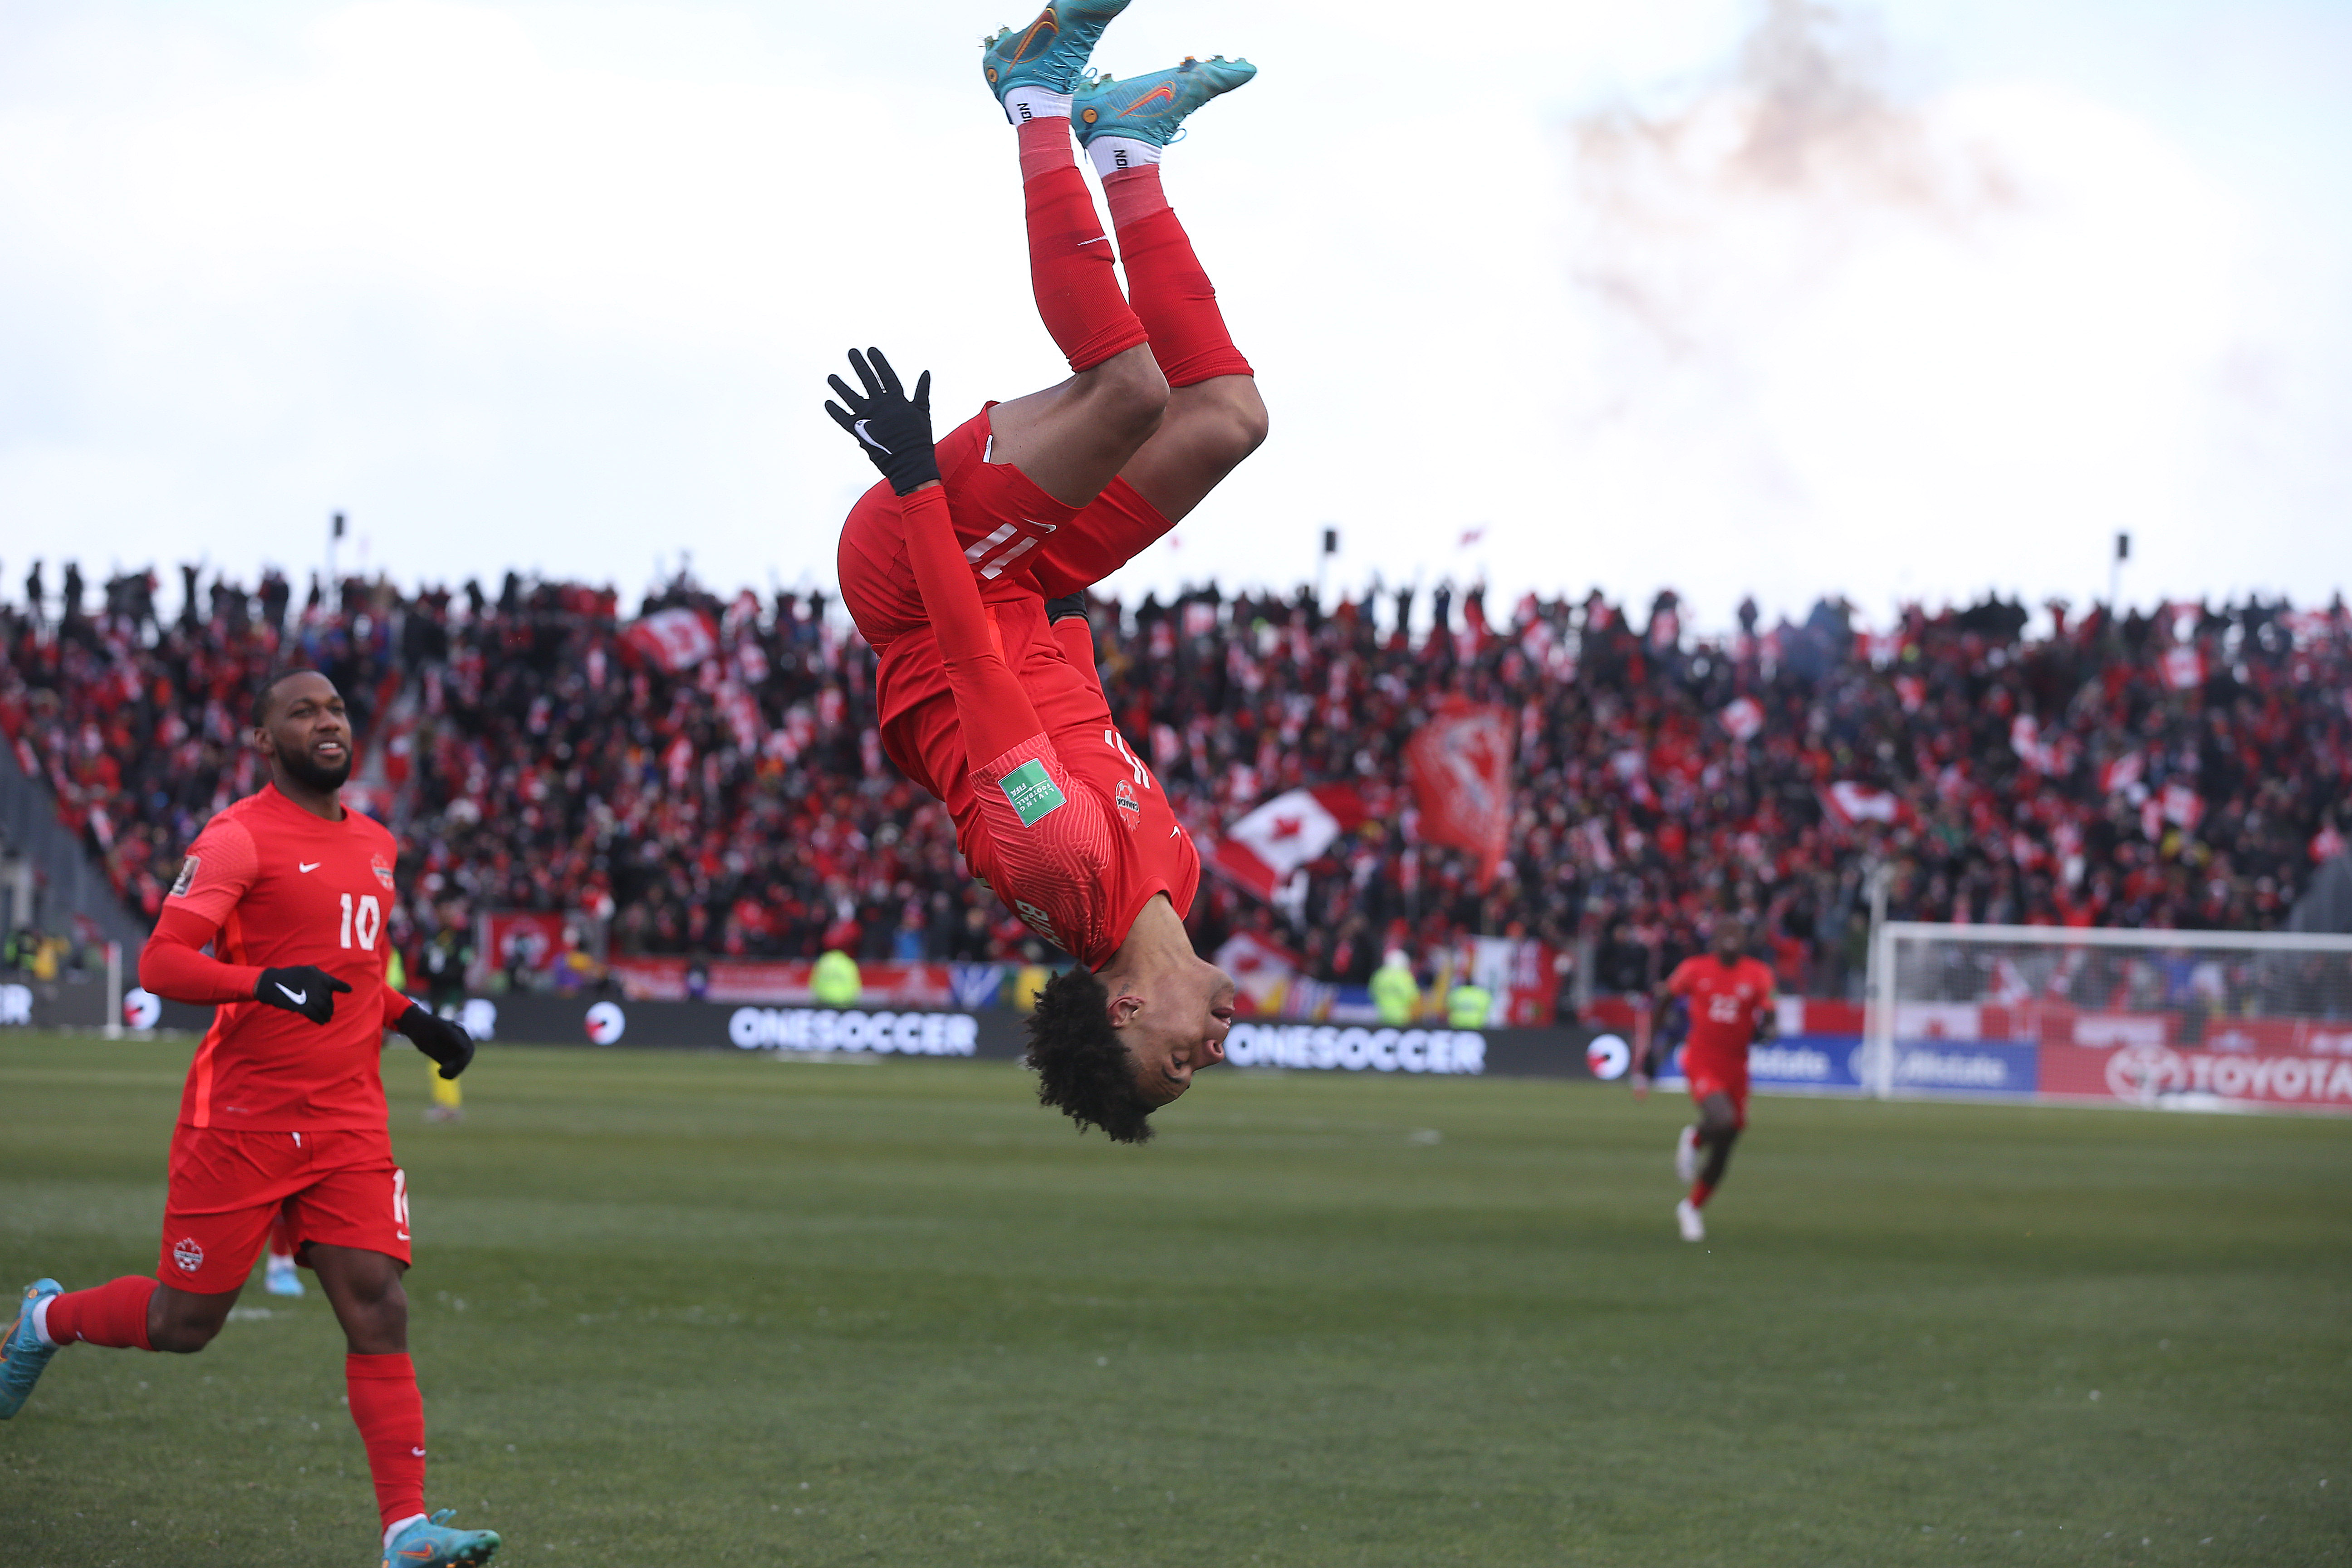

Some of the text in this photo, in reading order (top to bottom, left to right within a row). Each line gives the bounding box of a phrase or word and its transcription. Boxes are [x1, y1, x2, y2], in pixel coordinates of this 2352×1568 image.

[1010, 783, 1027, 798] FIFA
[1016, 783, 1051, 806] FOOTBALL
[1019, 788, 1054, 812] LIVING
[1117, 797, 1138, 811] CANADA
[340, 893, 381, 951] 10
[729, 1006, 978, 1056] ONESOCCER
[1225, 1023, 1487, 1075] ONESOCCER
